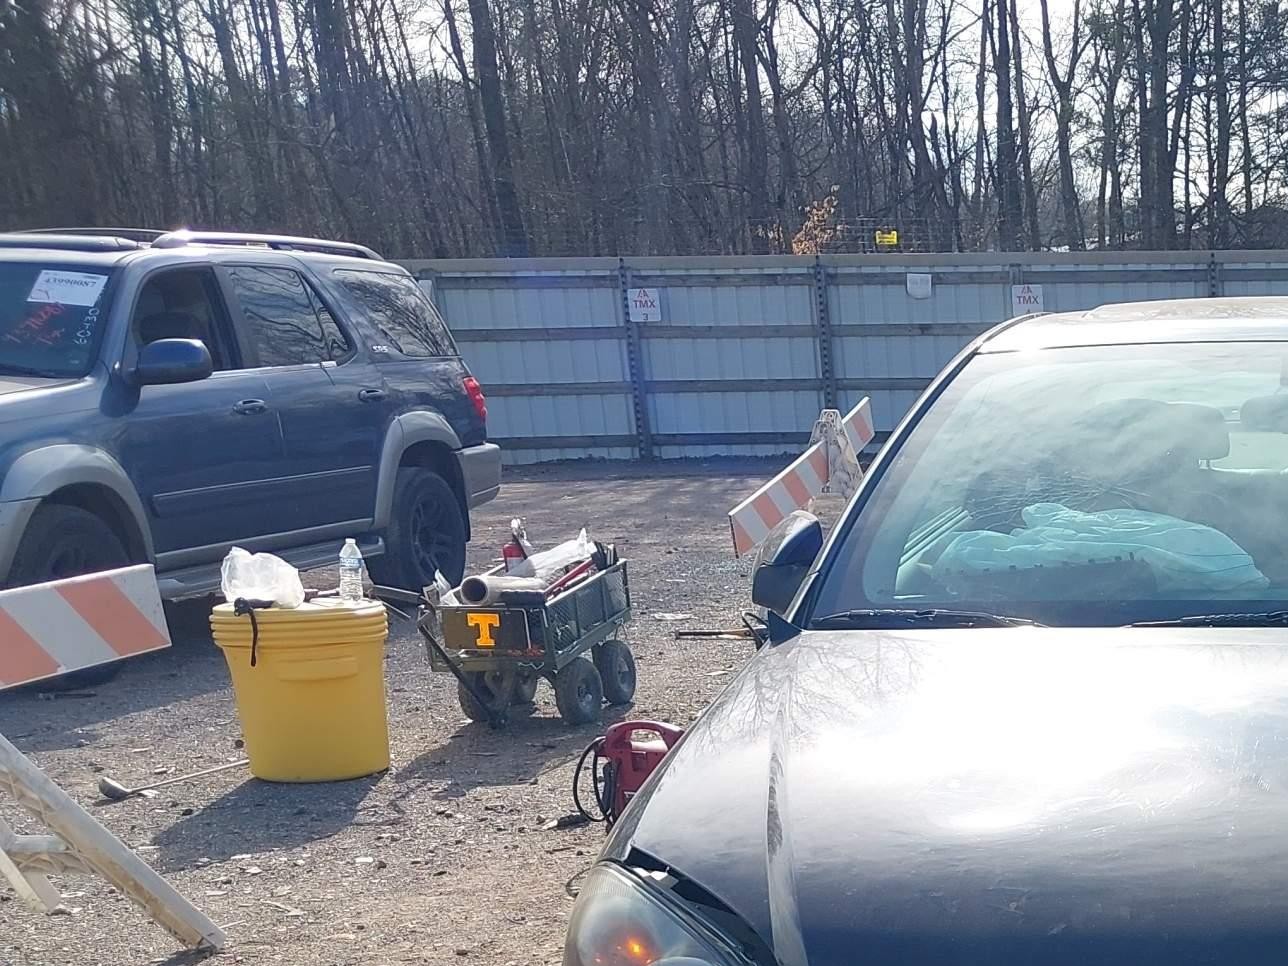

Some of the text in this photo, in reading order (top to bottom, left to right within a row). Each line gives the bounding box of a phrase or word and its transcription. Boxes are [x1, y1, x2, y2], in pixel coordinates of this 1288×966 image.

[632, 299, 656, 309] TMX
[1016, 295, 1040, 305] TMX
[466, 612, 501, 646] T
